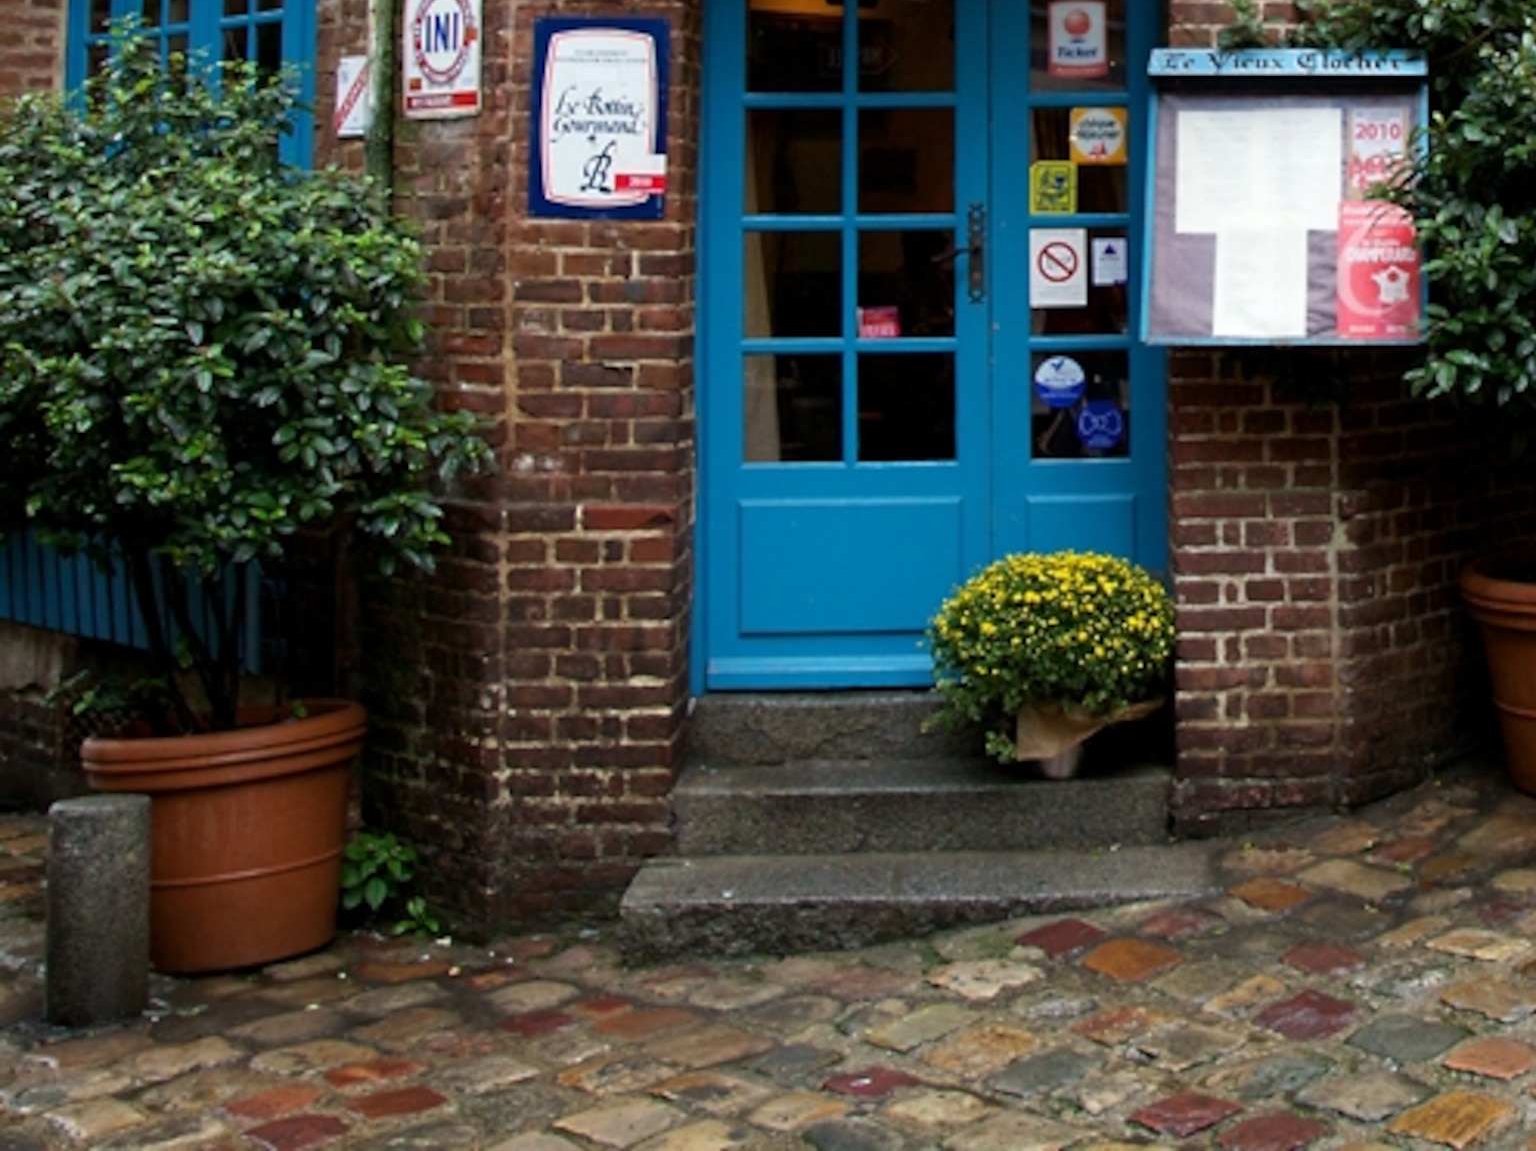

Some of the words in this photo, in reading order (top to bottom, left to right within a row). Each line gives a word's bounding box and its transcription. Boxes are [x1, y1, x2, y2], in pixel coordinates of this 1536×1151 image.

[1161, 52, 1196, 70] Le
[1207, 52, 1284, 74] Vieux
[1296, 52, 1403, 75] Clocher
[554, 84, 580, 116] Le
[550, 118, 647, 143] Gourmand
[1355, 121, 1402, 140] 2010
